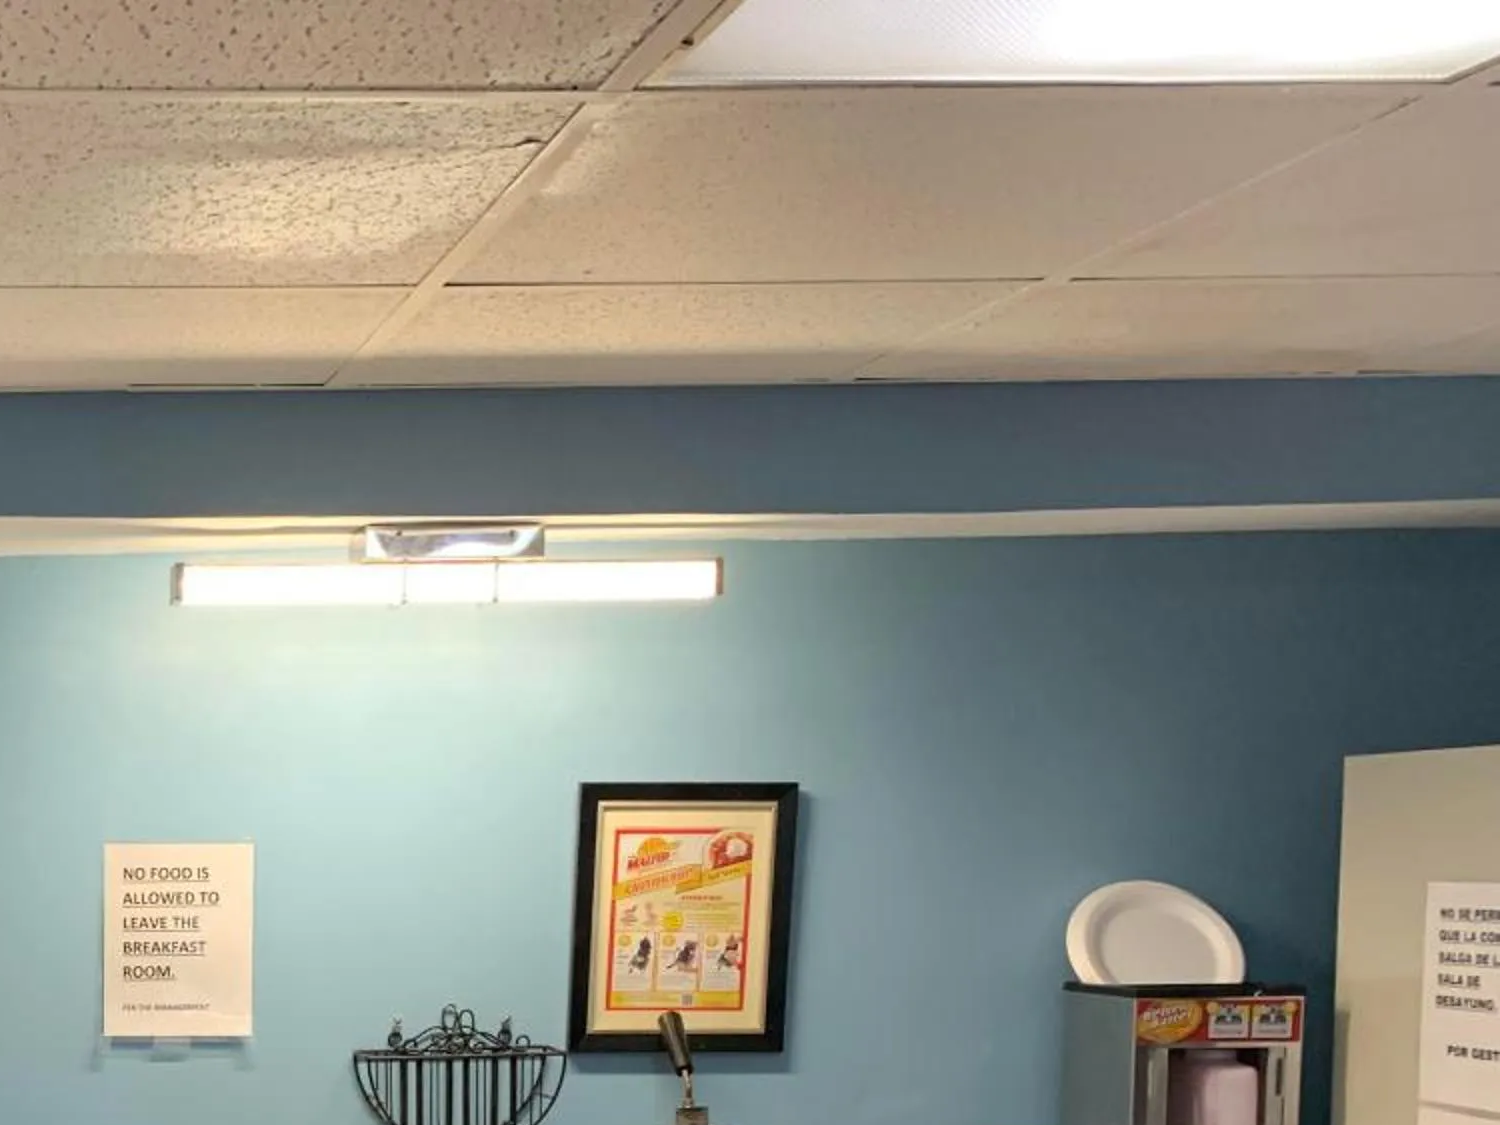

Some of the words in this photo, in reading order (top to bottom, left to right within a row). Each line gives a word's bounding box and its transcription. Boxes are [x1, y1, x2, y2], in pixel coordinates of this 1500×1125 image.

[123, 867, 145, 881] NO
[150, 867, 193, 881] FOOD
[197, 867, 210, 880] IS
[123, 892, 195, 905] ALLOWED
[199, 892, 220, 905] TO
[123, 916, 167, 929] LEAVE
[173, 916, 200, 929] THE
[1439, 930, 1460, 941] QUE
[1464, 931, 1476, 942] LA
[123, 941, 207, 954] BREAKFAST
[1475, 953, 1489, 965] DE
[123, 965, 175, 979] ROOM.
[1438, 973, 1463, 985] SALA
[1466, 975, 1480, 987] DE
[1447, 1045, 1468, 1058] POR
